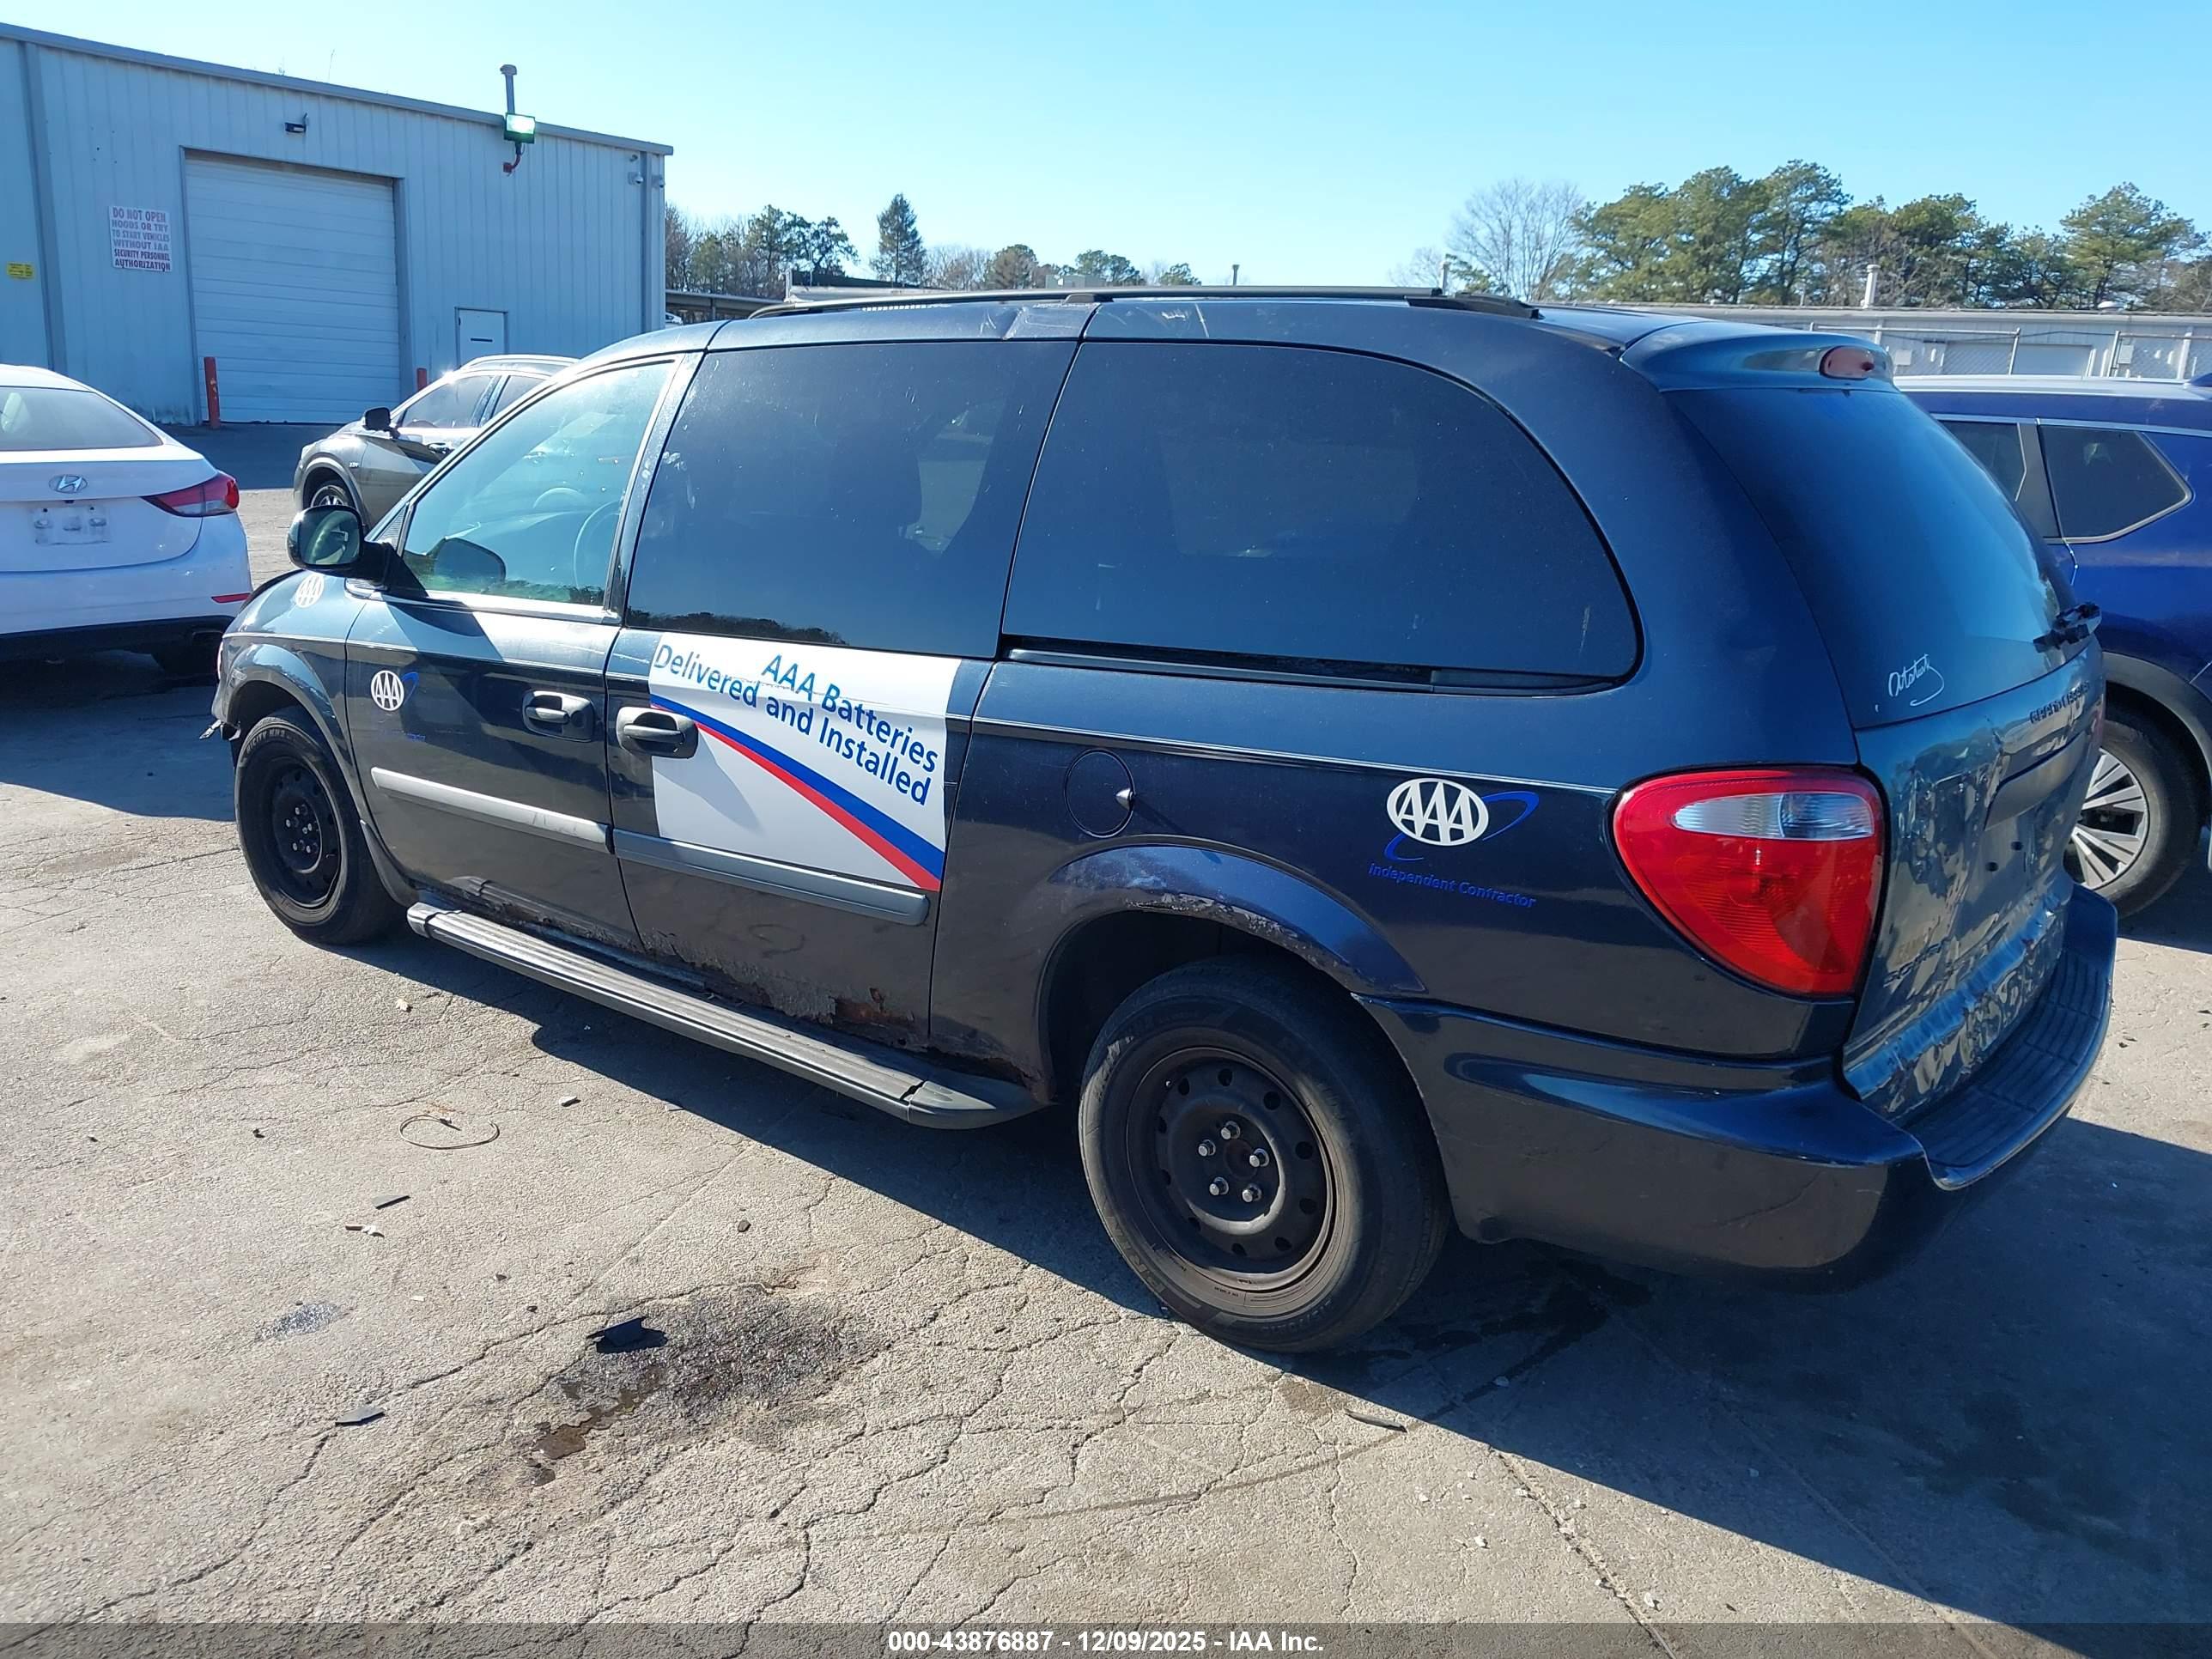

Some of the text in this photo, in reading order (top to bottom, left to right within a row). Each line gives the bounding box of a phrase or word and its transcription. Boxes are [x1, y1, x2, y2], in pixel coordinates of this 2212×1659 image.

[112, 207, 166, 223] DO NOT OPEN
[112, 219, 168, 233] HOODS OR TRY
[112, 228, 170, 242] TO START VEHICLES
[112, 239, 151, 250] WITHOUT
[114, 248, 170, 262] SECURITY PERSONNEL
[115, 258, 171, 270] AUTHORIZATION
[371, 671, 404, 711] AAA
[761, 653, 939, 773] AAA Batteries
[654, 644, 932, 805] Delivered and Installed
[1389, 779, 1486, 846] AAA
[1368, 863, 1537, 908] Independent Contractor
